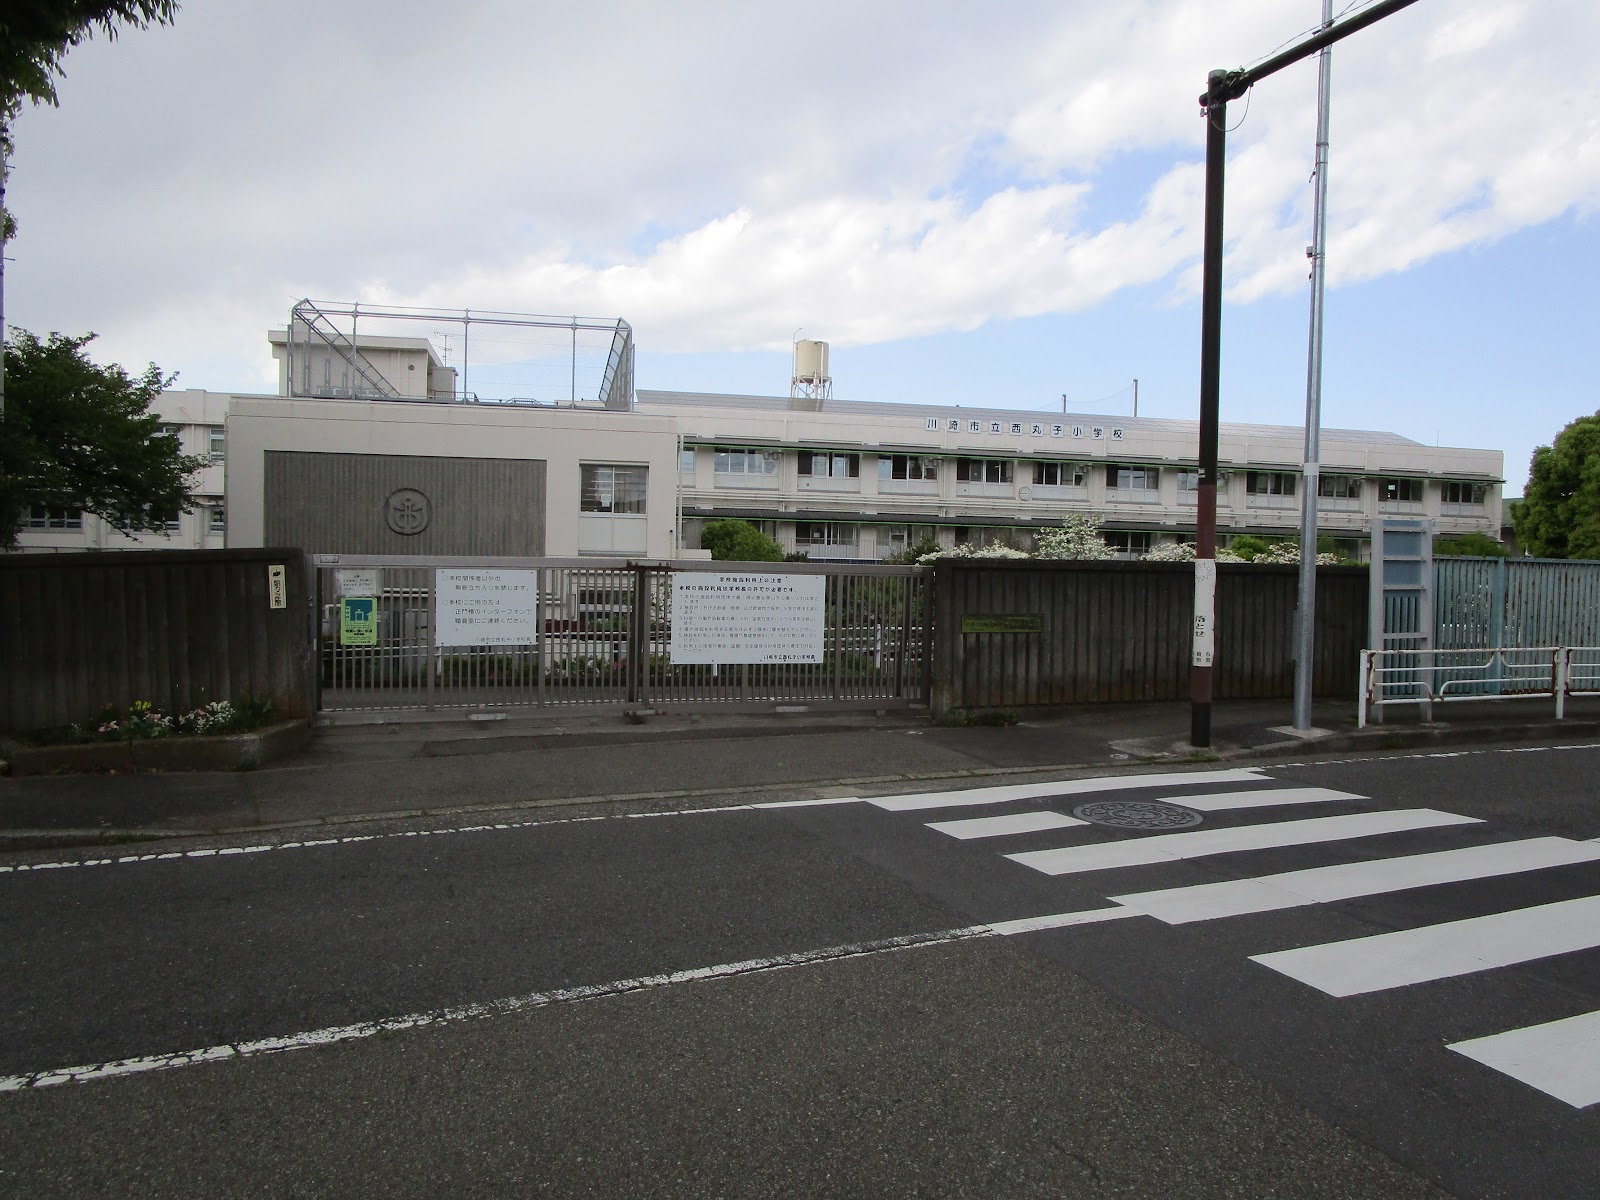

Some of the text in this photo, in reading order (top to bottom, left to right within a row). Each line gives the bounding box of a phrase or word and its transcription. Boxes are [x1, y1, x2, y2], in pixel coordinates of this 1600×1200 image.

[927, 418, 1124, 440] 川崎市立西丸子小学校
